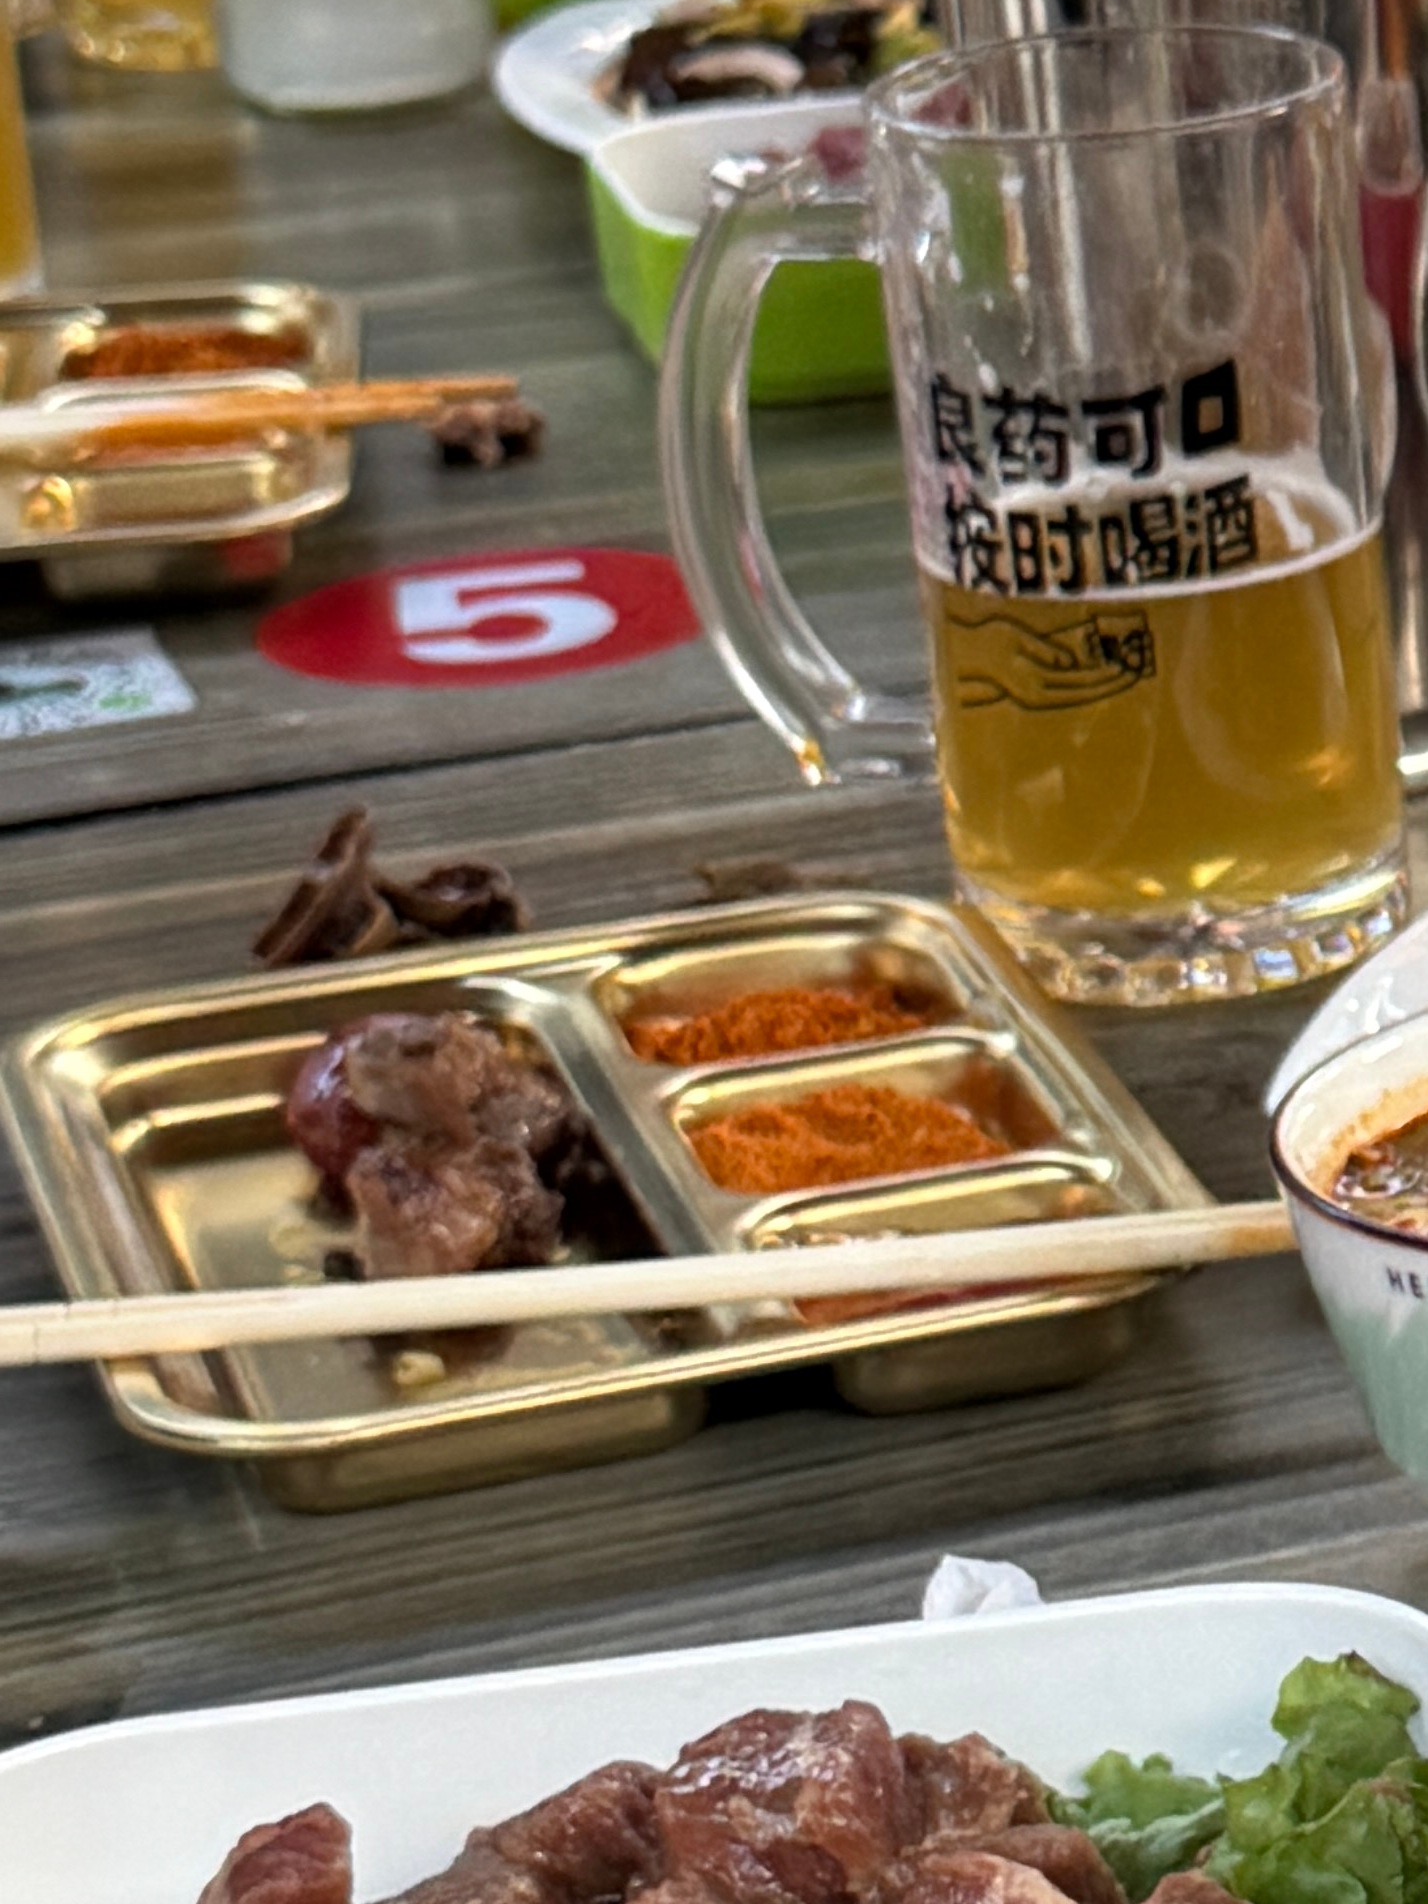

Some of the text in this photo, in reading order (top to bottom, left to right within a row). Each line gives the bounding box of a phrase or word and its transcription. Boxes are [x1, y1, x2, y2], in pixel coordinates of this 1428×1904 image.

[931, 359, 1241, 486] 良药可口
[945, 474, 1258, 594] 按时喝酒
[391, 559, 617, 664] 5
